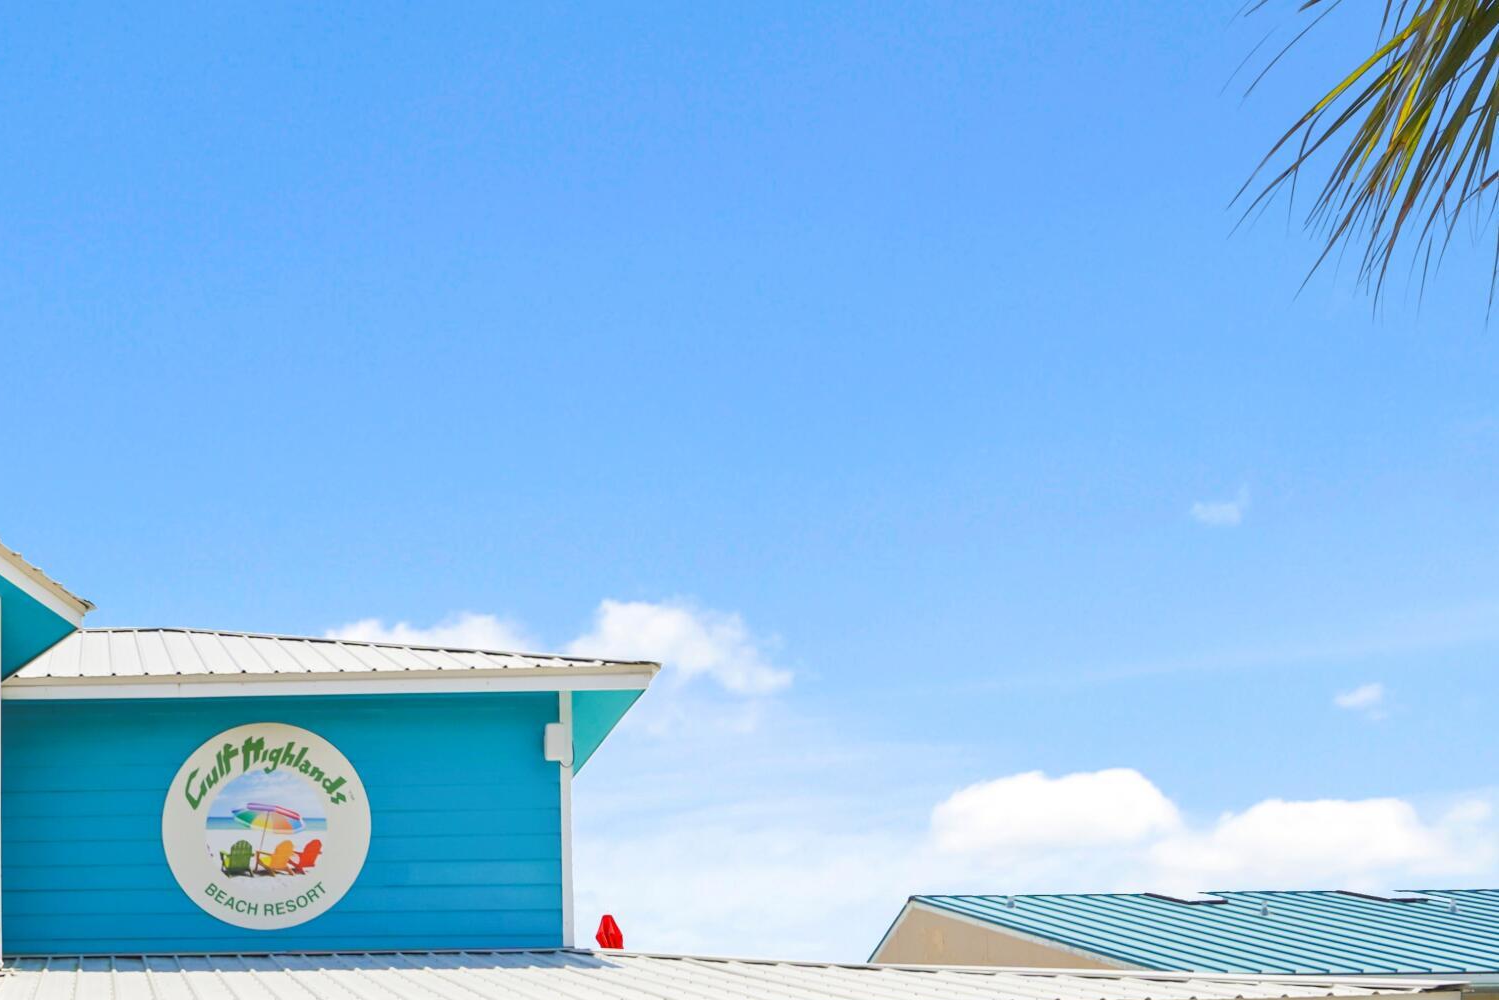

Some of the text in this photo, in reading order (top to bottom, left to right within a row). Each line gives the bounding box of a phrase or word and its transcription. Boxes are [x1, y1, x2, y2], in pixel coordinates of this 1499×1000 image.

[185, 736, 347, 810] Gulf Highlands
[204, 881, 327, 916] BEACH RESORT
